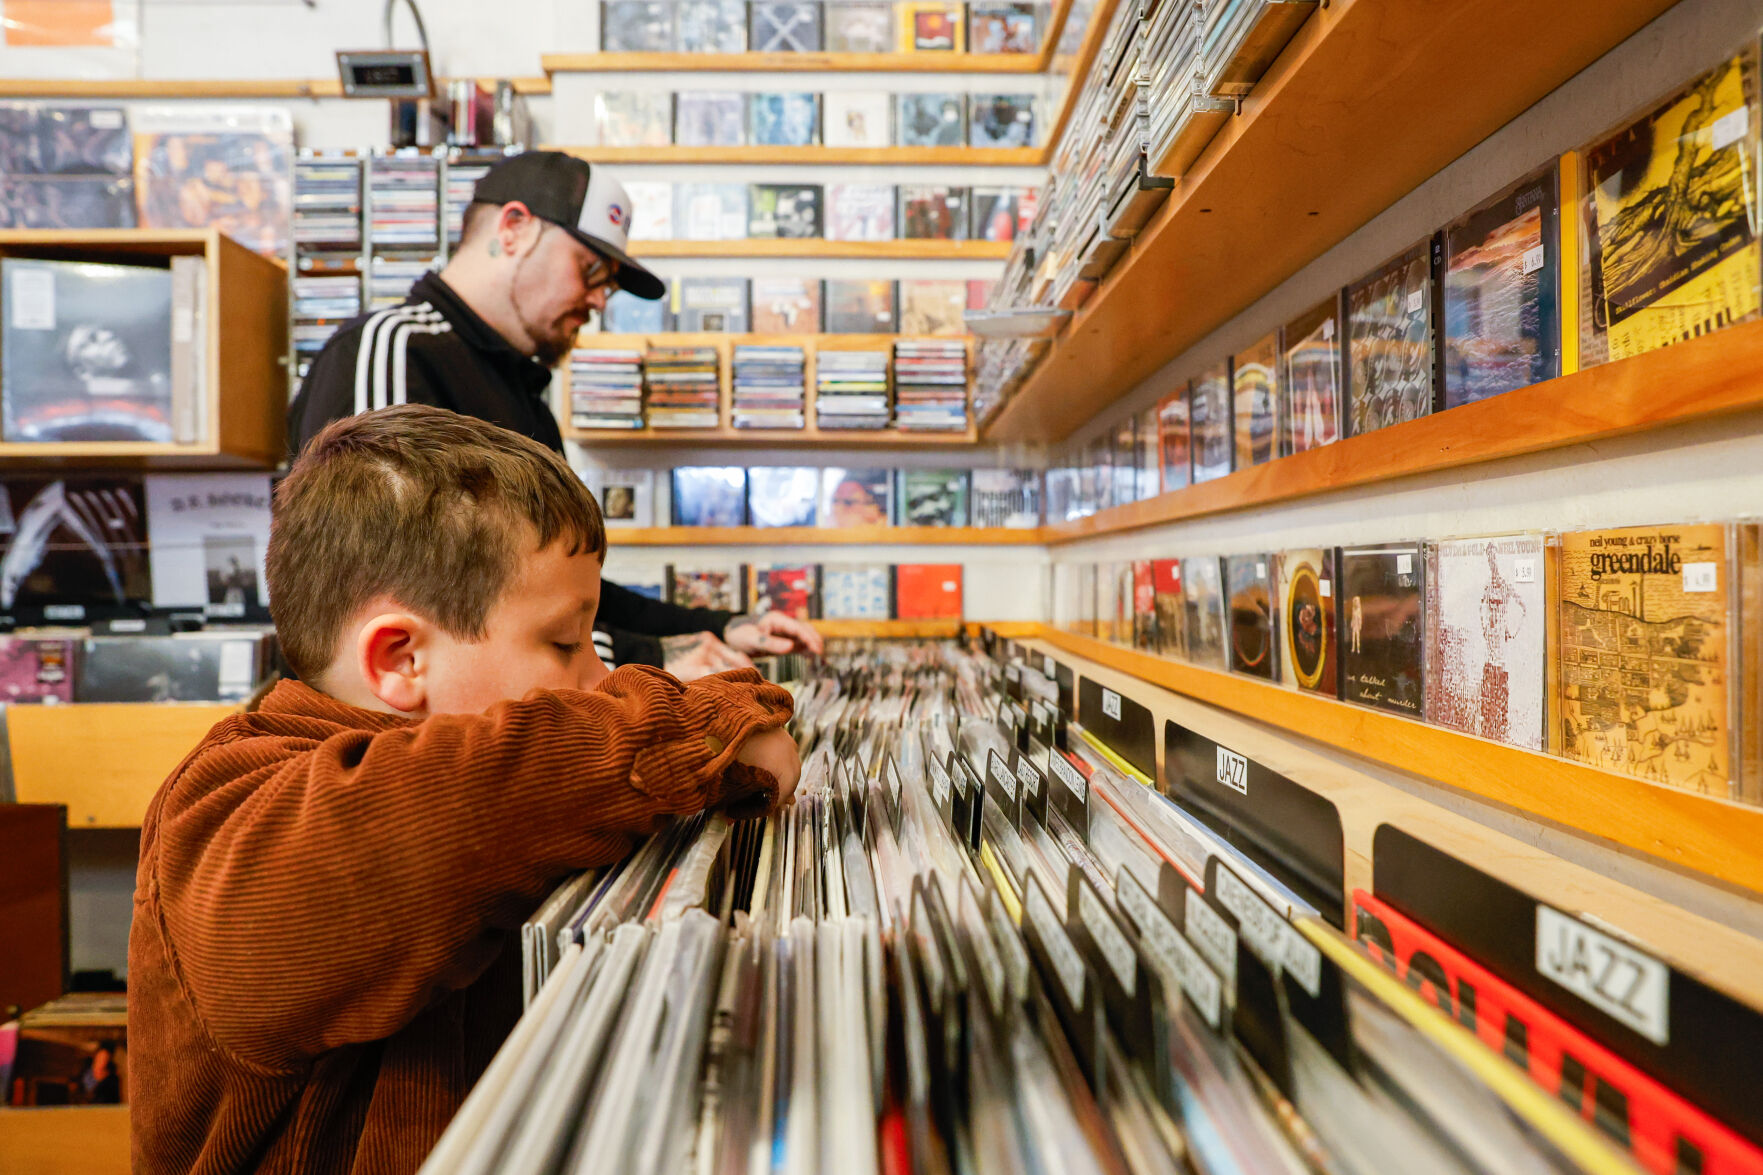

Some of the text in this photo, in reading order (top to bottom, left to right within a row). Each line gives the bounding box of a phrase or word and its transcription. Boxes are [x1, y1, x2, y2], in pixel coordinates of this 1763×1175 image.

[1590, 536, 1603, 547] neil
[1604, 536, 1628, 549] young
[1659, 532, 1681, 544] horse
[1590, 544, 1681, 581] greendale
[1219, 752, 1246, 790] JAZZ
[1547, 923, 1650, 1022] JAZZ
